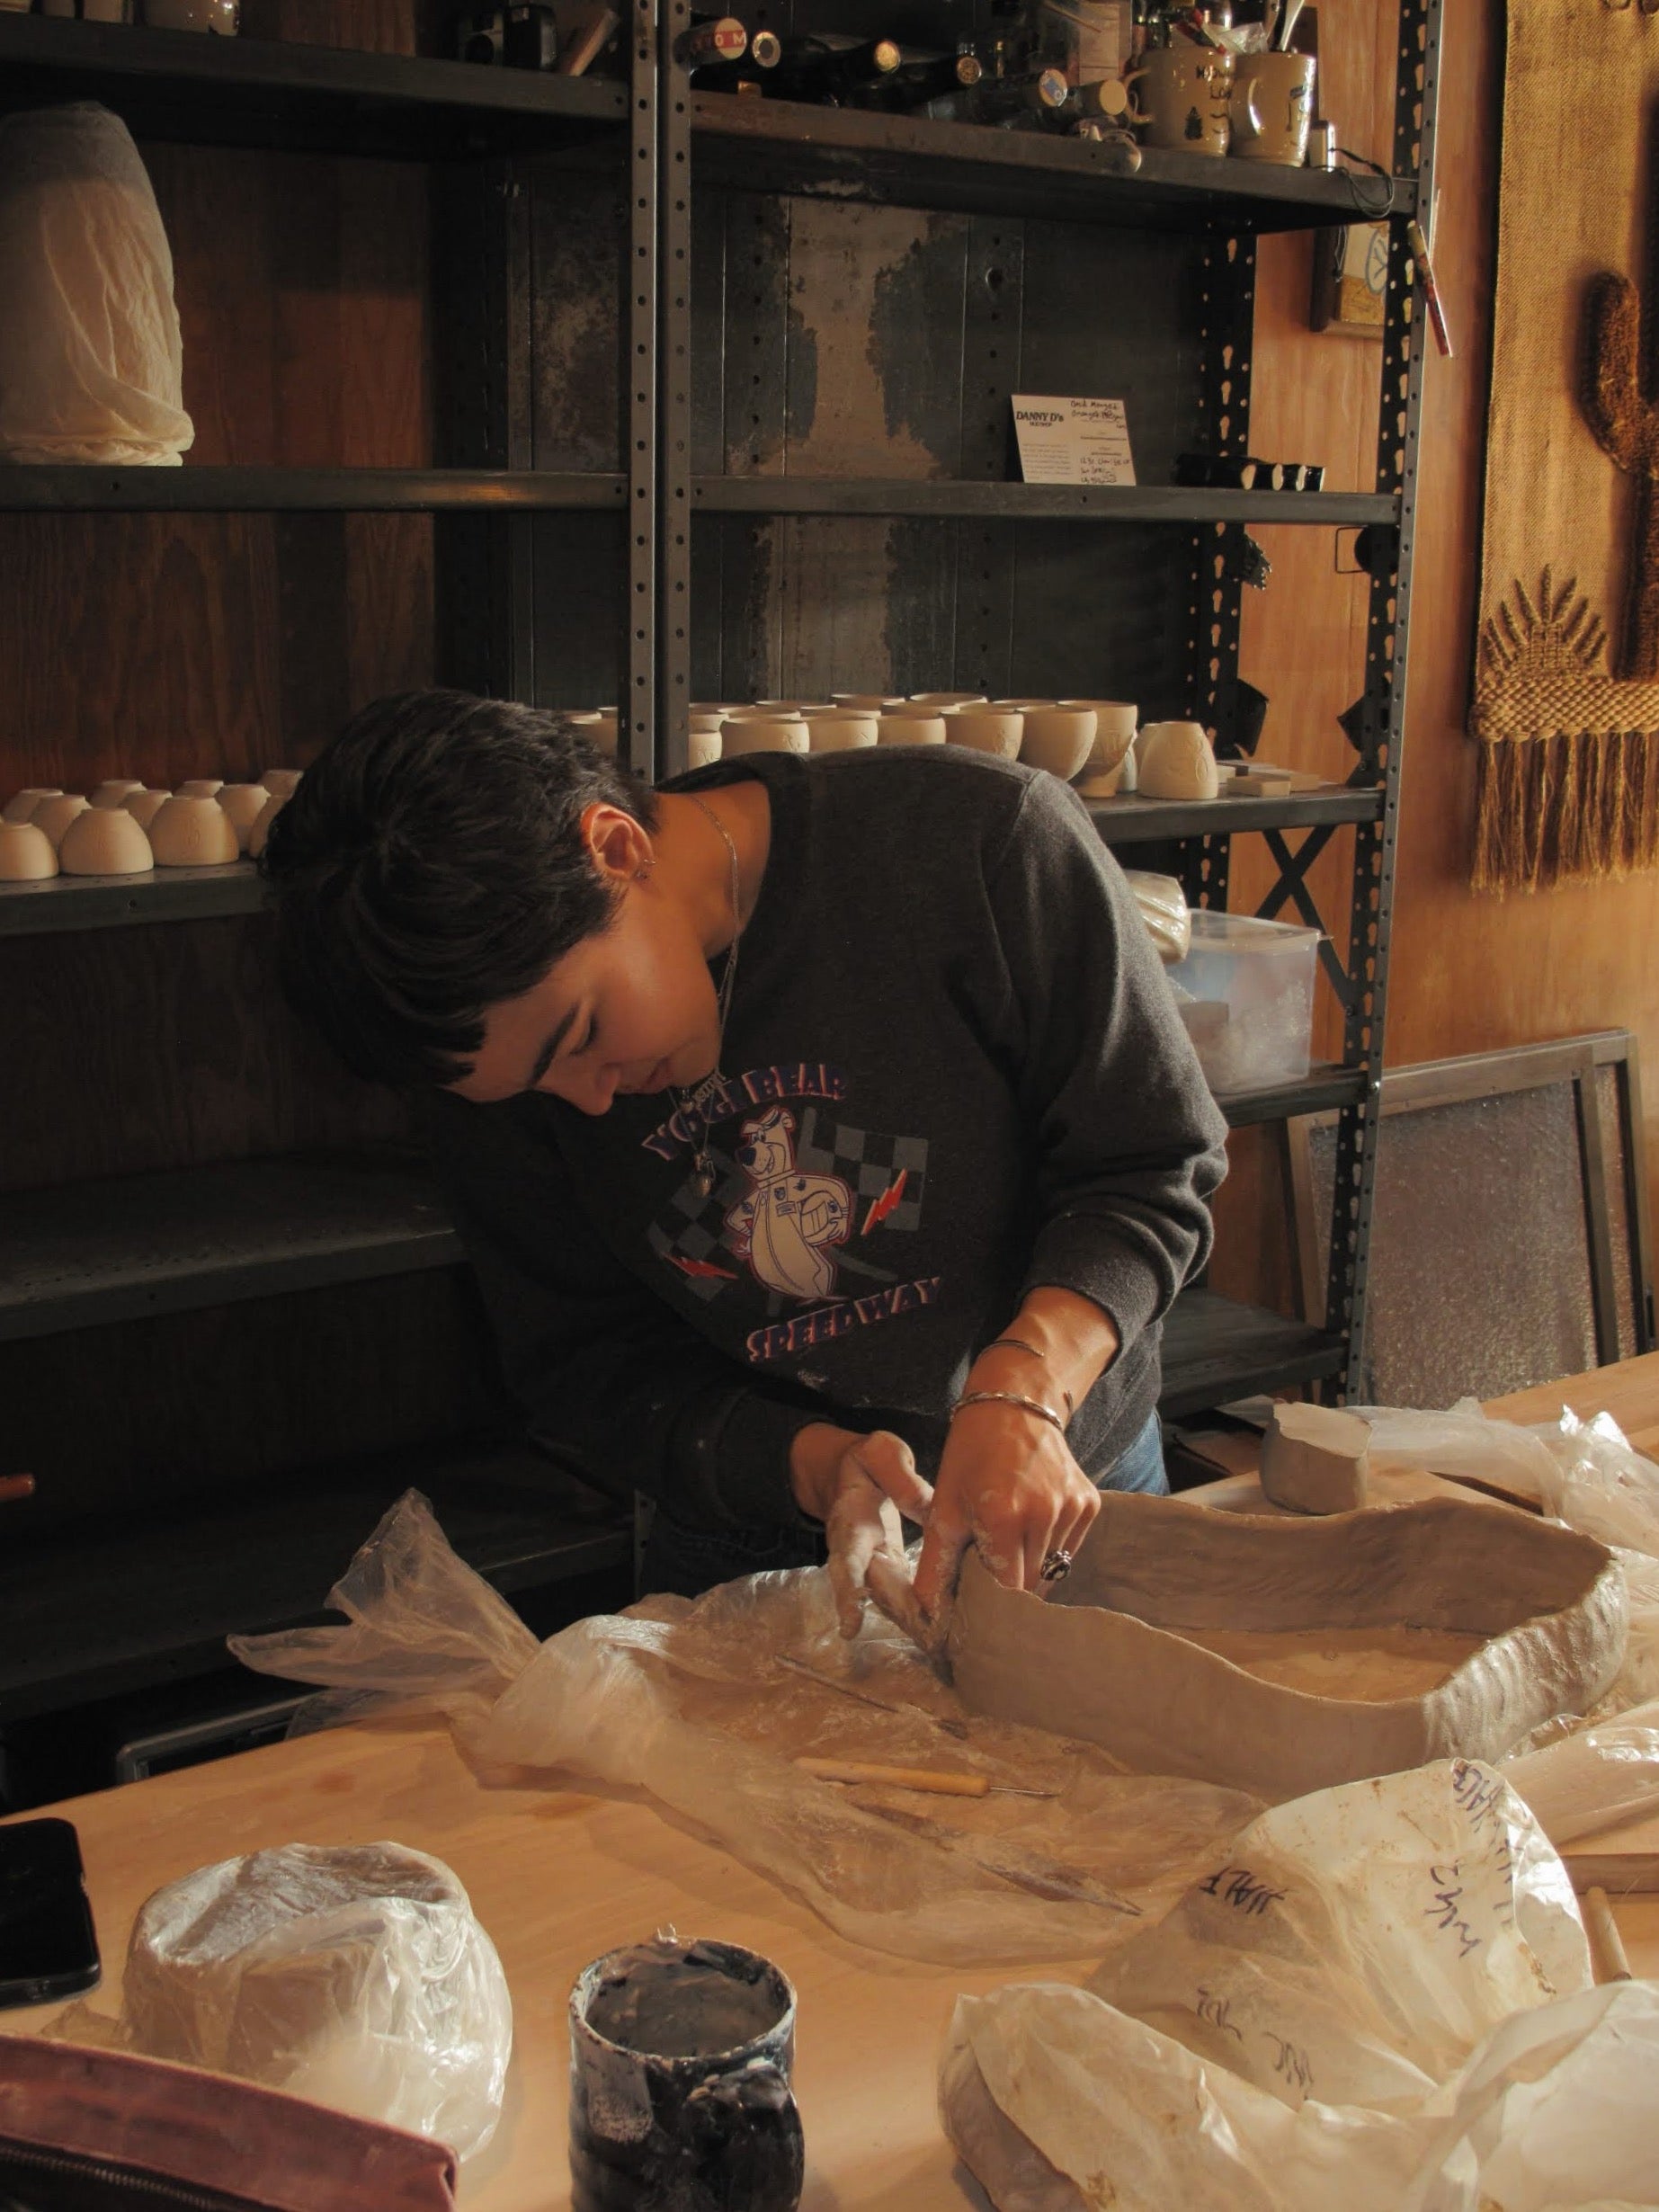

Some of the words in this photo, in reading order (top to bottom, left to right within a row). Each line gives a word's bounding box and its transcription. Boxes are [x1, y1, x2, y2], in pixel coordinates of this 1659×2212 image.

[1016, 411, 1048, 422] DANNY
[740, 1062, 849, 1105] BEAR
[745, 1275, 941, 1363] SPEEDWAY
